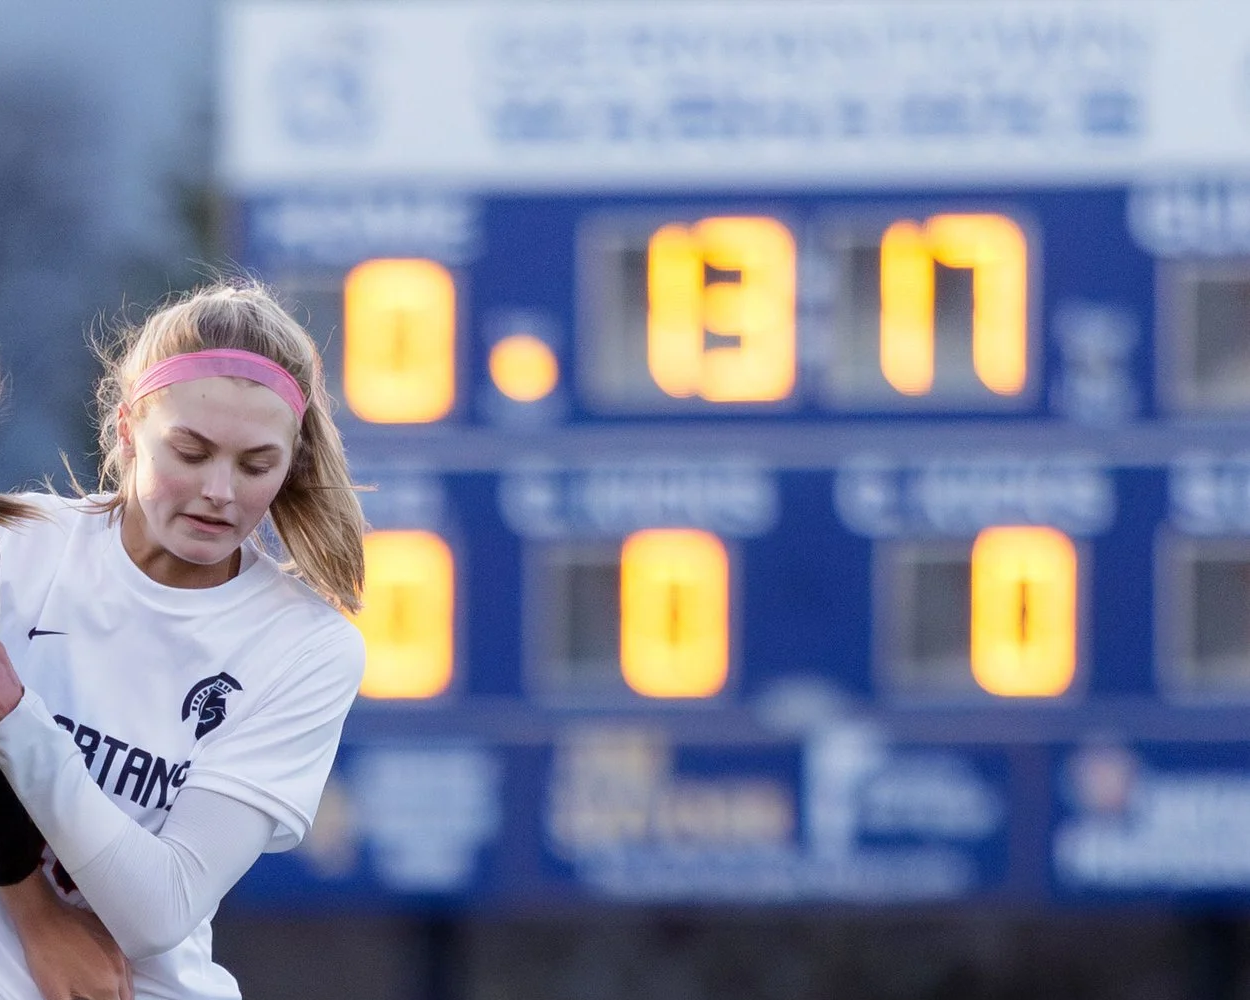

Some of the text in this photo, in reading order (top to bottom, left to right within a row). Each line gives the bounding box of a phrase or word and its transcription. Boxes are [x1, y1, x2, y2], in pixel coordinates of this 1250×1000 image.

[345, 259, 456, 424] 0
[363, 530, 455, 699] 0
[620, 529, 729, 698] 0
[971, 526, 1078, 697] 0
